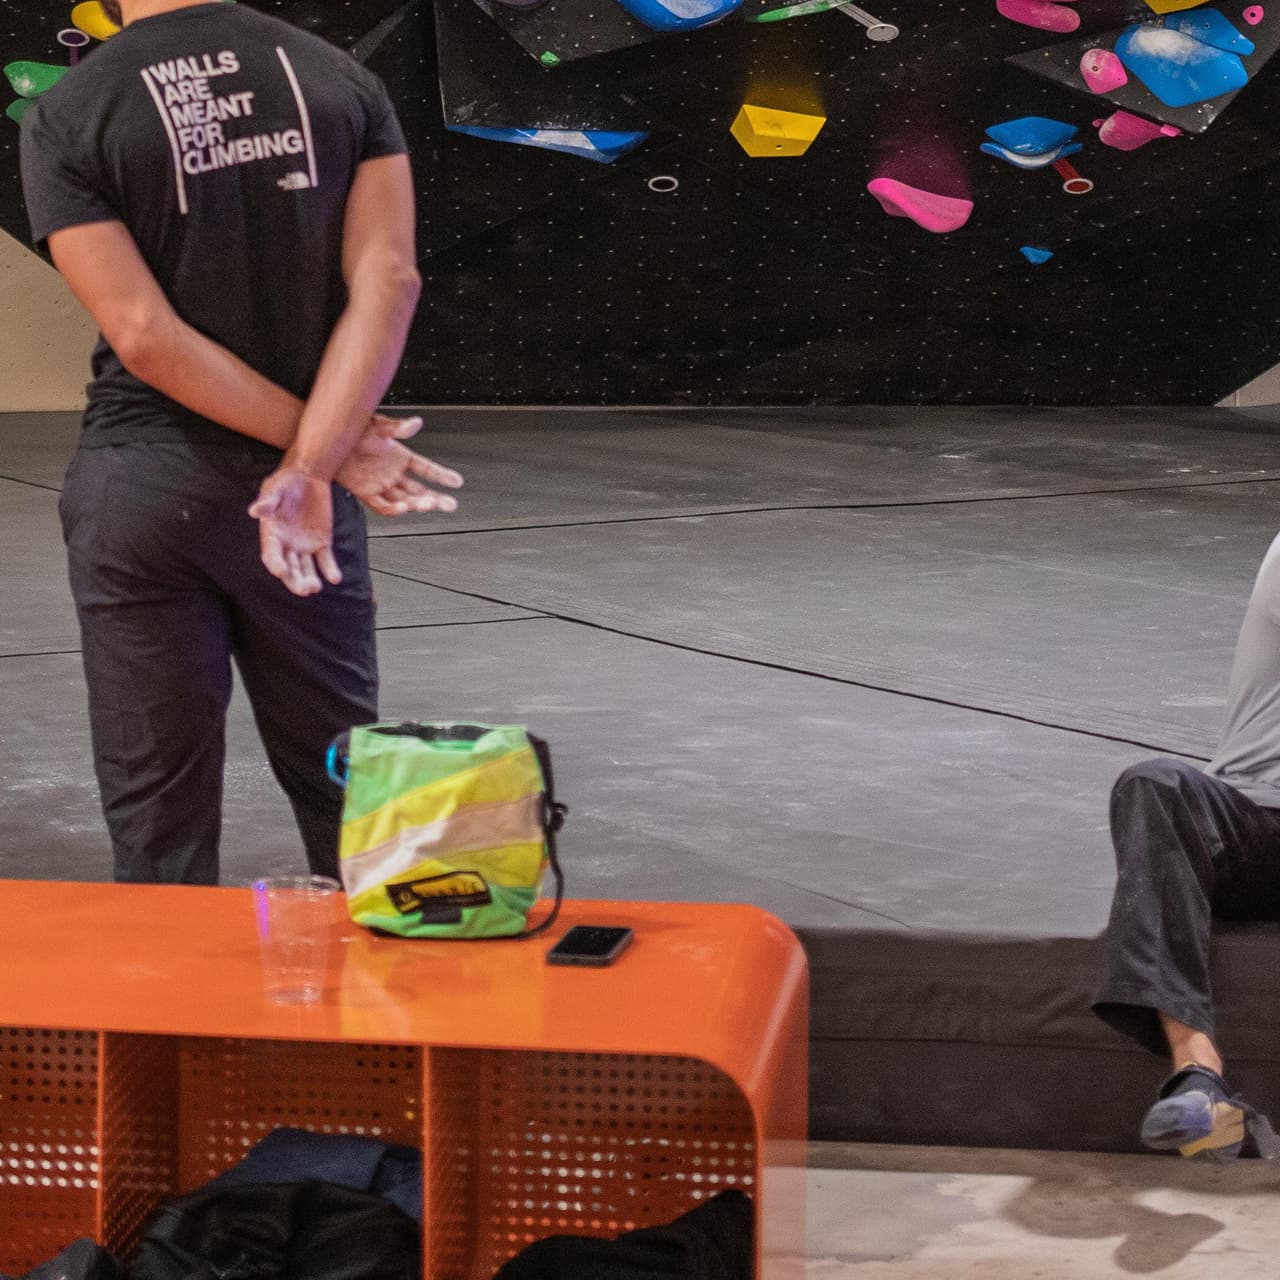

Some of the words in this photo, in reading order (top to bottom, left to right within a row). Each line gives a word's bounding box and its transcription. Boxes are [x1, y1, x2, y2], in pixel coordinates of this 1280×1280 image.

[149, 50, 240, 84] WALLS
[164, 78, 213, 106] ARE
[169, 91, 254, 128] MEANT
[176, 121, 225, 152] FOR
[183, 129, 304, 174] CLIMBING
